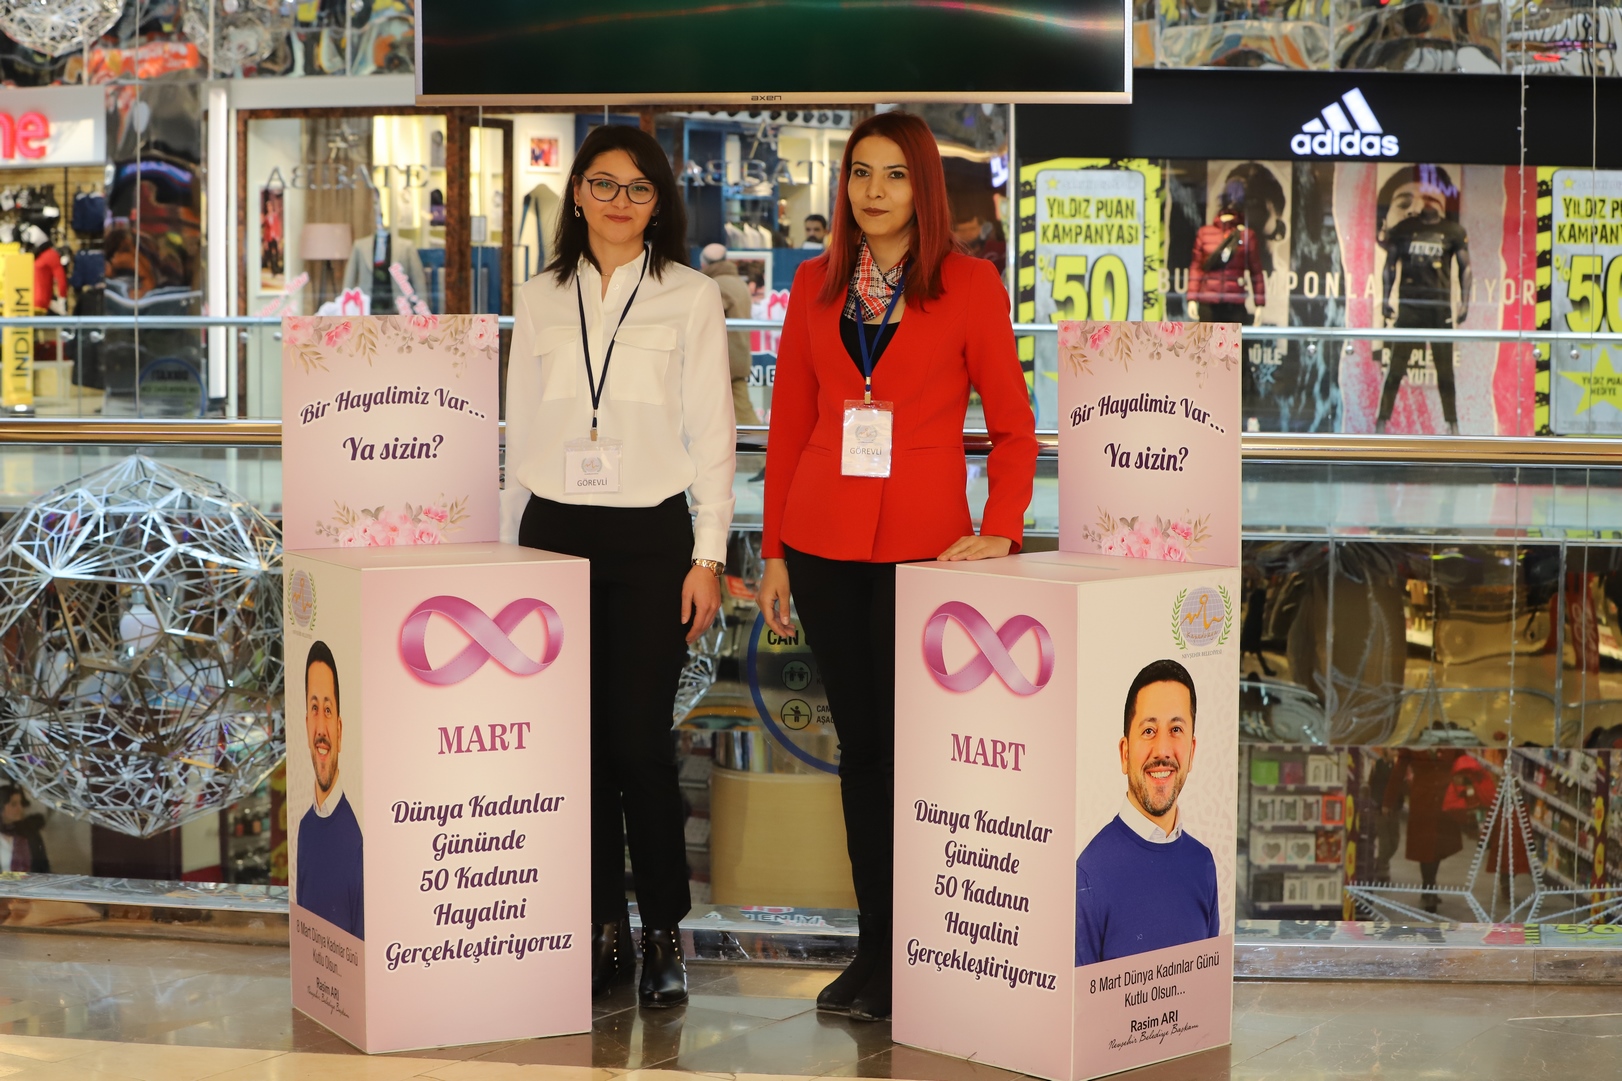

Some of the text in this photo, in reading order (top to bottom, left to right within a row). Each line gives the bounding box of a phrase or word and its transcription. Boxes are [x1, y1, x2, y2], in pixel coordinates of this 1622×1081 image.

[1290, 128, 1400, 157] adidas
[1046, 197, 1135, 220] YILDIZ PUAN
[1563, 197, 1606, 220] YILDIZ
[1040, 223, 1139, 245] KAMPANYASI
[1157, 267, 1190, 294] BU
[11, 287, 30, 377] İNDİİM
[299, 385, 486, 425] Bir Hayalimiz Var...
[1070, 392, 1225, 433] Bir Hayalimiz Var...
[342, 434, 444, 461] Ya sizin?
[849, 446, 882, 456] GÖREVLİ
[1103, 442, 1189, 472] Ya sizin?
[576, 477, 608, 487] GÖREVLİ
[437, 721, 531, 755] MART
[950, 733, 1026, 772] MART
[391, 792, 565, 827] Dünya Kadınlar
[914, 799, 1053, 843] Dünya Kadınlar
[432, 829, 526, 861] Gününde
[944, 840, 1020, 874] Gününde
[419, 866, 539, 892] 50 Kadının
[934, 874, 1030, 912] 50 Kadının
[433, 897, 527, 930] Hayalini
[944, 911, 1020, 946] Hayalini
[385, 933, 573, 971] Gerçekleştiriyoruz
[906, 938, 1057, 991] Gerçekleştiriyoruz
[1089, 951, 1220, 994] 8 Mart Dünya Kadınlar Günü
[1124, 984, 1186, 1007] Kutlu Olsun...
[1130, 1009, 1179, 1033] Rasim ARI
